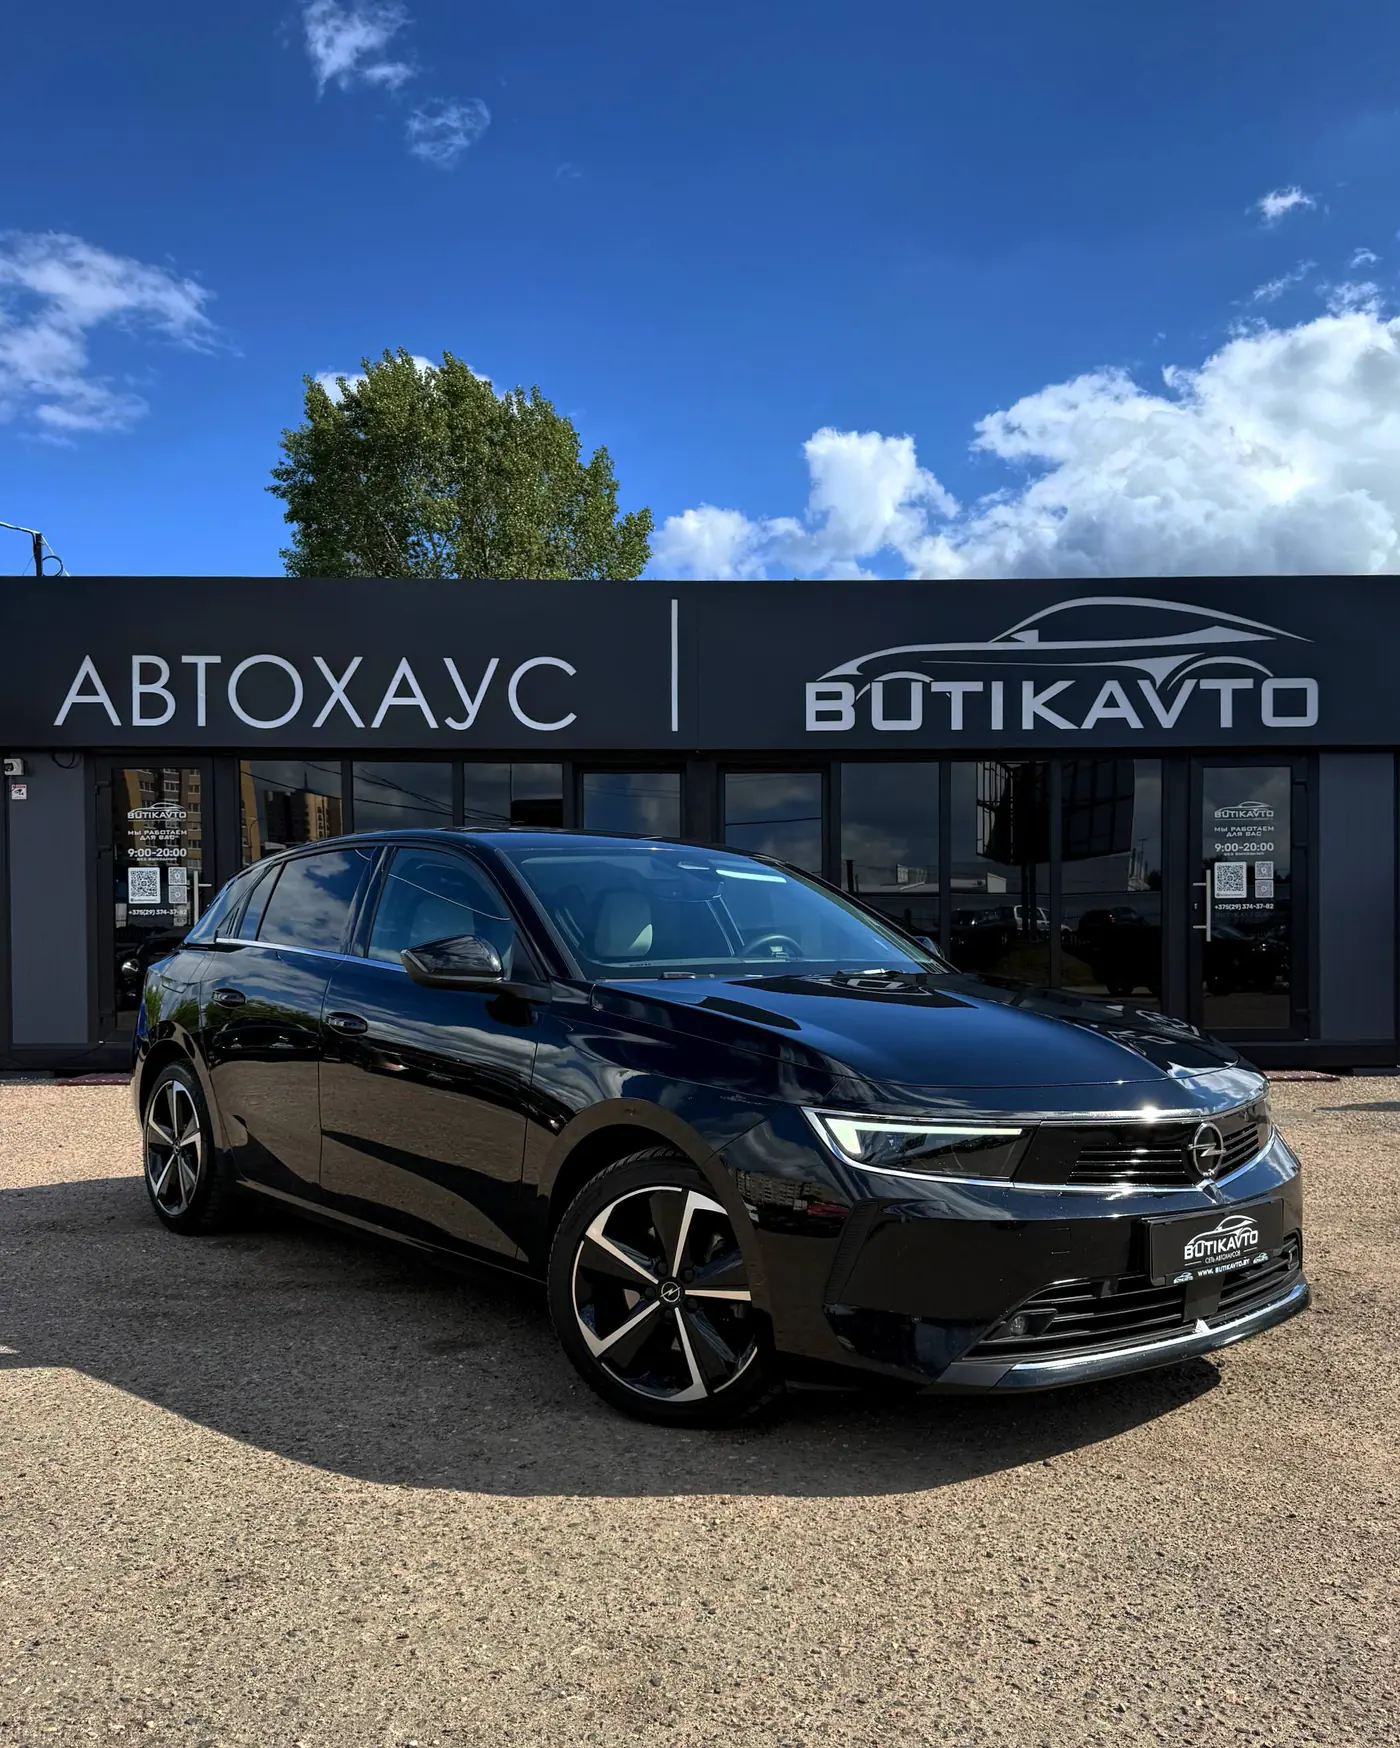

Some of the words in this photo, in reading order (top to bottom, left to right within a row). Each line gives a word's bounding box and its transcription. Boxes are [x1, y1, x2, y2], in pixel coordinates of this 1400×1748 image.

[53, 653, 578, 732] АВТОХАУС
[804, 677, 1319, 732] BUTIKAVTO
[127, 811, 187, 819] BUTIKAVTO
[1214, 810, 1274, 818] BUTIKAVTO
[1214, 842, 1274, 852] 9:00-20:00
[127, 848, 187, 857] 9:00-20:00
[1184, 1230, 1258, 1260] BUTIKAVTO
